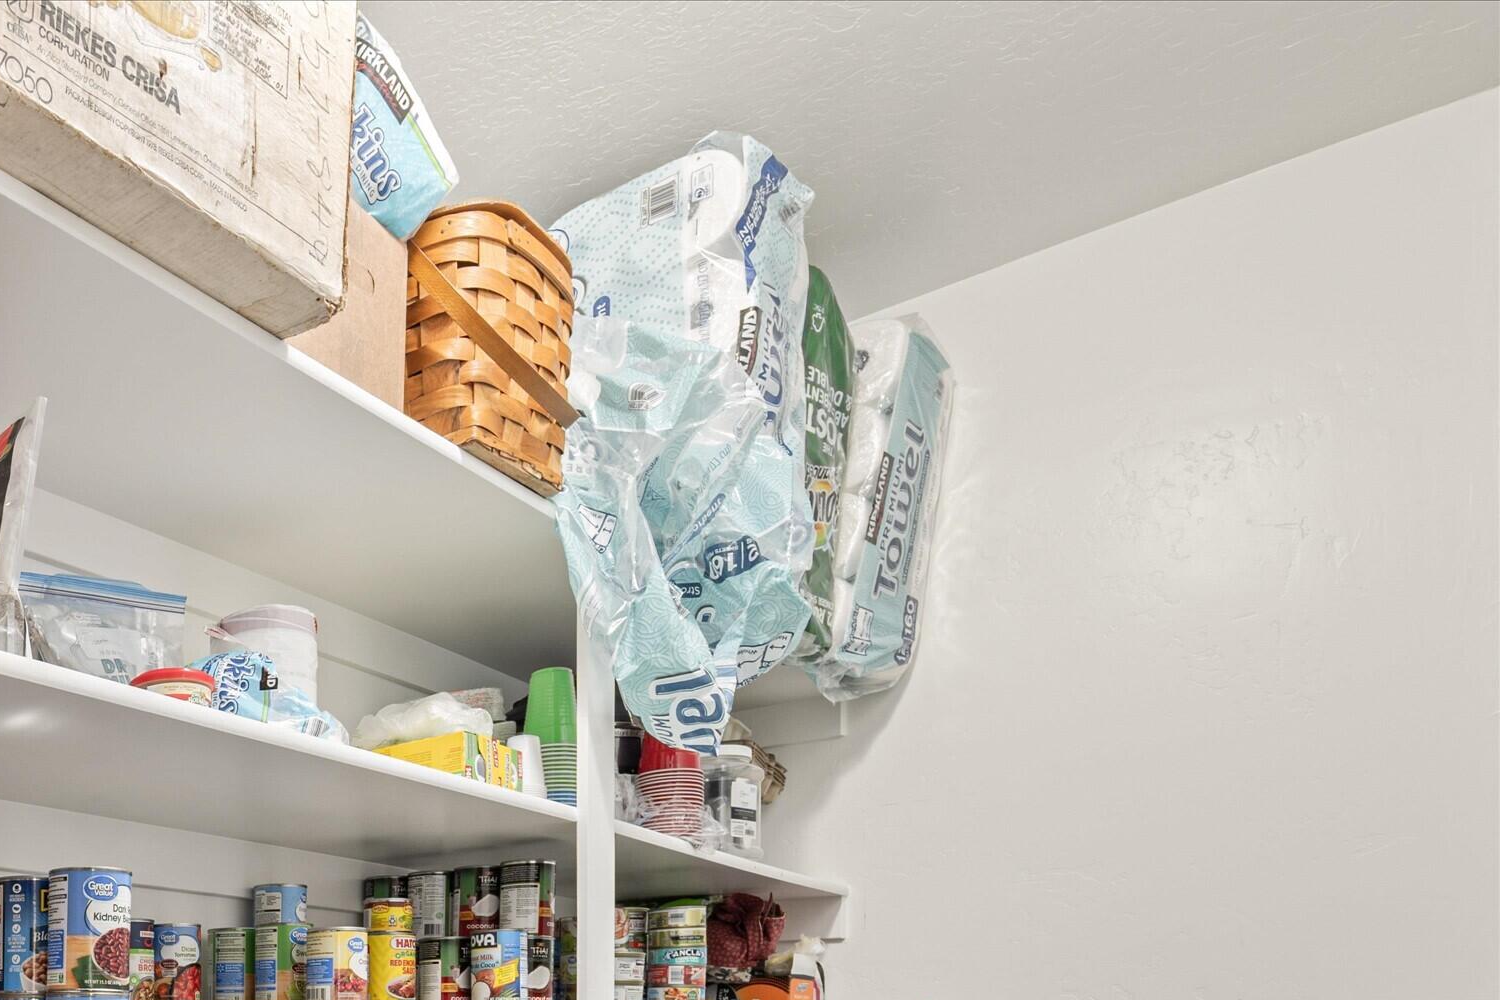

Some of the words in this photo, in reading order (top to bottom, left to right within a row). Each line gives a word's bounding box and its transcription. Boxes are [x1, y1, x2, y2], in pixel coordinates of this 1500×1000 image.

[39, 26, 110, 81] CORPORATION
[40, 0, 116, 68] RIEKES
[122, 55, 181, 115] CRISA
[872, 419, 928, 599] Towel
[88, 881, 114, 892] Great
[94, 889, 114, 897] Value
[112, 903, 127, 914] Dark
[93, 913, 121, 924] Kidney
